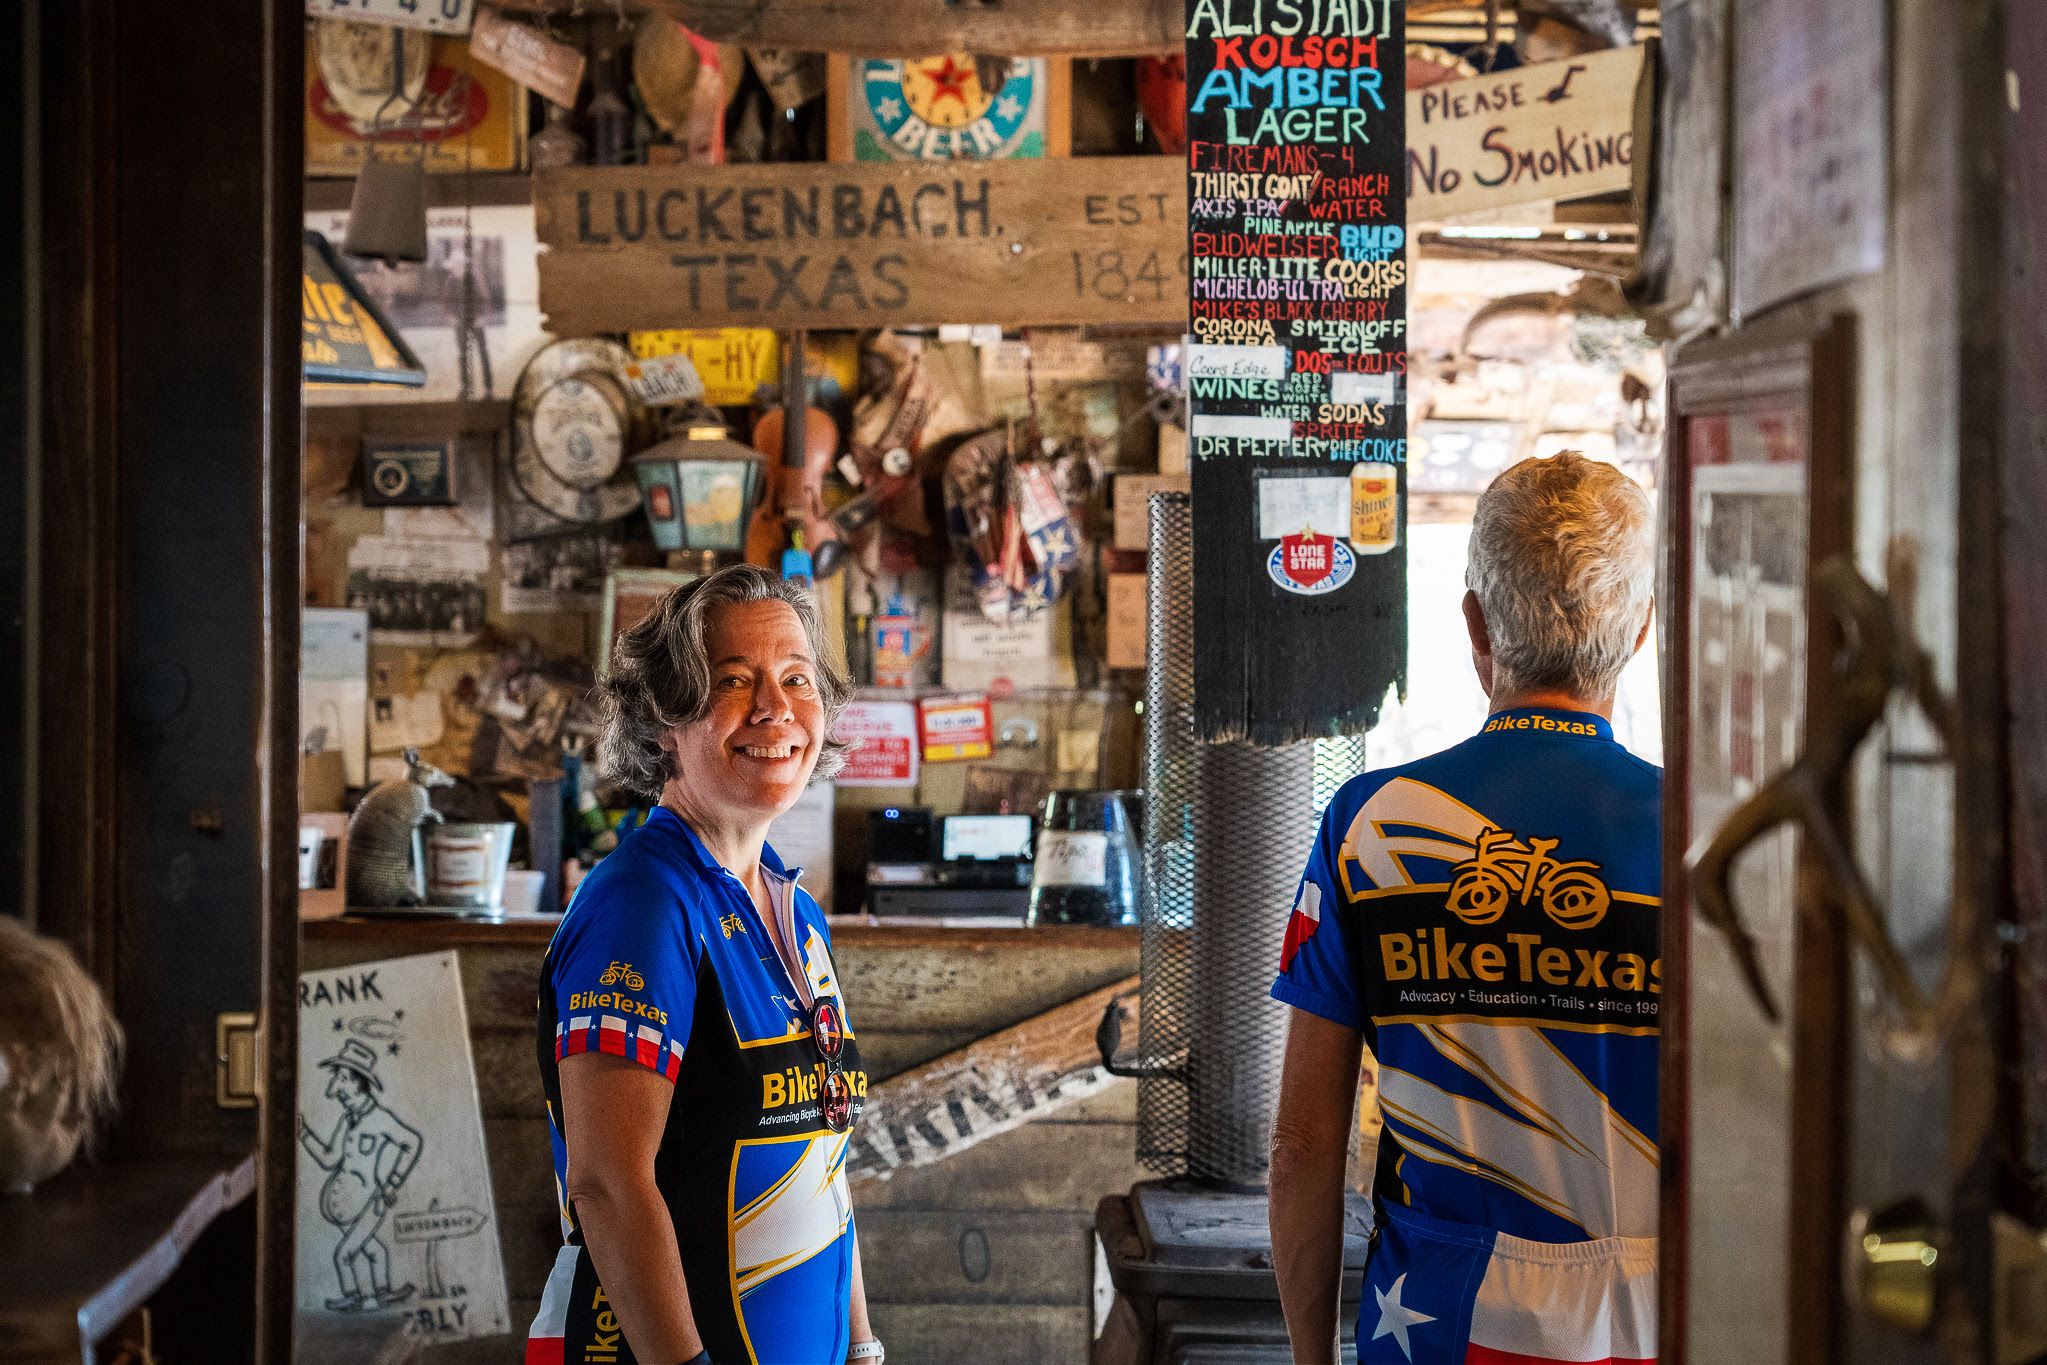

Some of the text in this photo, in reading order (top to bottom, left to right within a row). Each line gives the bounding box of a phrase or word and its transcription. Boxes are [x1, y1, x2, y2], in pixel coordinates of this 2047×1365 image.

[1213, 35, 1378, 69] KOLSCH
[1190, 66, 1386, 112] AMBER
[1422, 82, 1526, 124] PLEASE
[1224, 107, 1370, 145] LAGER
[1191, 172, 1263, 200] THIRST
[1322, 175, 1390, 199] RANCH
[1084, 192, 1169, 226] EST
[1191, 197, 1281, 218] AXIS IPA
[1310, 199, 1387, 220] WATER
[1193, 231, 1340, 259] BUDWEISER
[1340, 223, 1405, 250] BUD
[1344, 246, 1395, 262] LIGHT
[670, 254, 912, 311] TEXAS
[1324, 257, 1406, 286] COORS
[1343, 281, 1396, 299] LIGHT
[1192, 299, 1388, 321] MIKE'S BLACK CHERRY
[1193, 316, 1276, 337] CORONA
[1290, 319, 1407, 338] SMIRNOFF
[1319, 336, 1381, 355] ICE
[1295, 350, 1332, 374] DOS
[1191, 376, 1280, 402] WINES
[1261, 404, 1312, 423] WATER
[1318, 402, 1387, 427] SODAS
[1292, 421, 1367, 441] SPRITE
[1199, 437, 1231, 457] DR
[1237, 435, 1321, 459] PEPPER
[1361, 438, 1408, 463] COKE
[1290, 544, 1326, 557] LONE
[1290, 557, 1326, 571] STAR
[1484, 715, 1598, 737] BikeTexas
[569, 990, 668, 1026] BikeTexas
[1400, 990, 1456, 1005] Advocacy
[1469, 989, 1538, 1006] Education
[1548, 994, 1585, 1010] Trails
[1598, 999, 1632, 1014] since
[759, 1111, 800, 1126] Advancing
